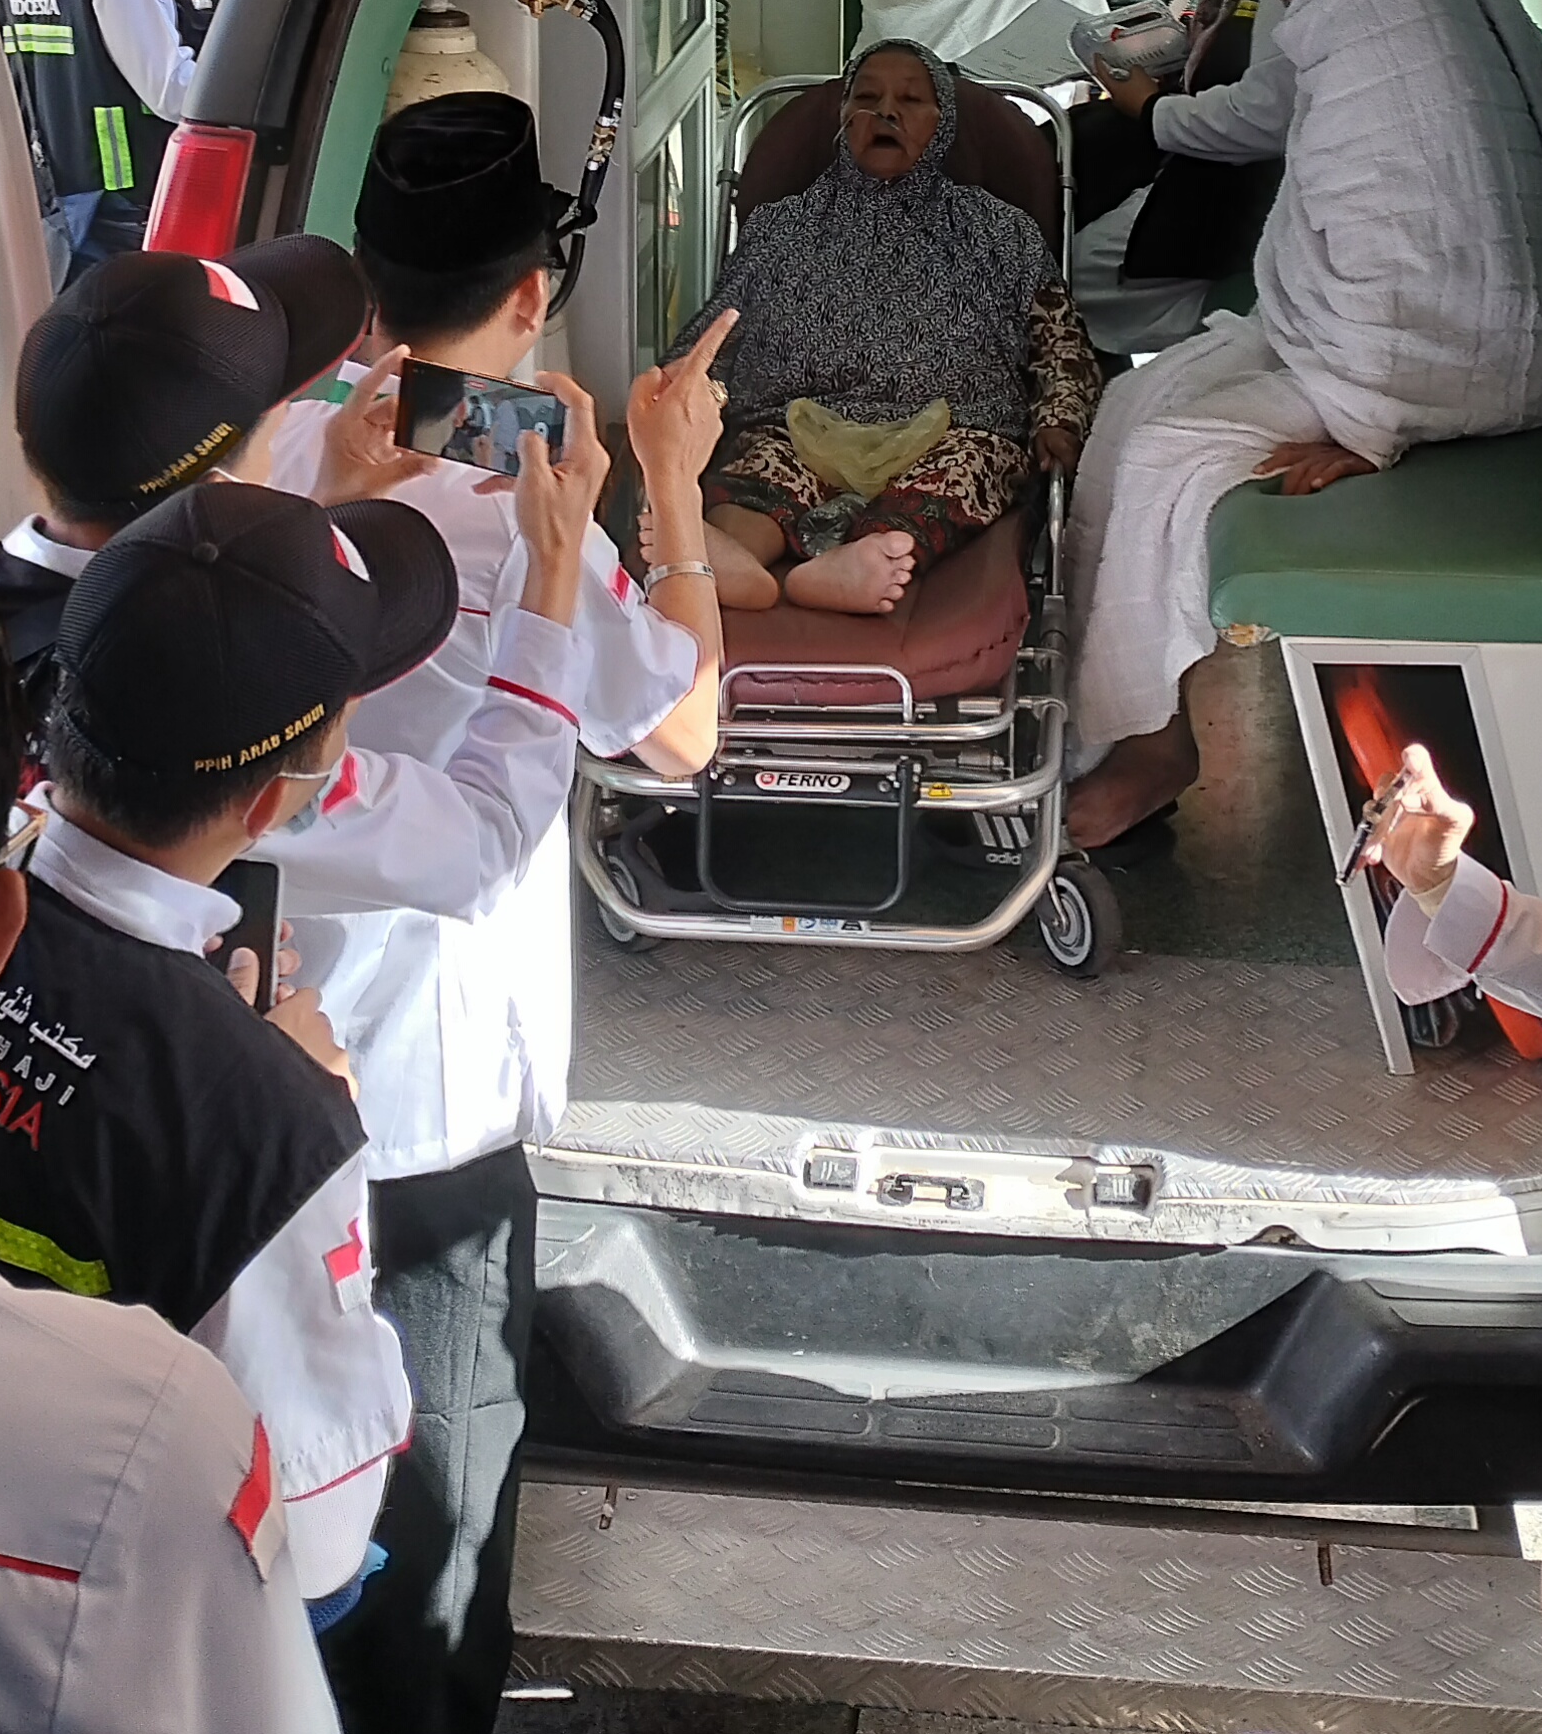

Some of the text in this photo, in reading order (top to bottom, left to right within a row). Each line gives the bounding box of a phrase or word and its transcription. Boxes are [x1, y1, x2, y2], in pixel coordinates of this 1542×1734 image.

[193, 421, 233, 456] SAUDI
[194, 703, 325, 772] PPIH ARAB SAUDI
[776, 773, 842, 788] FERNO
[985, 851, 1022, 866] adid
[29, 1021, 97, 1070] مكتب
